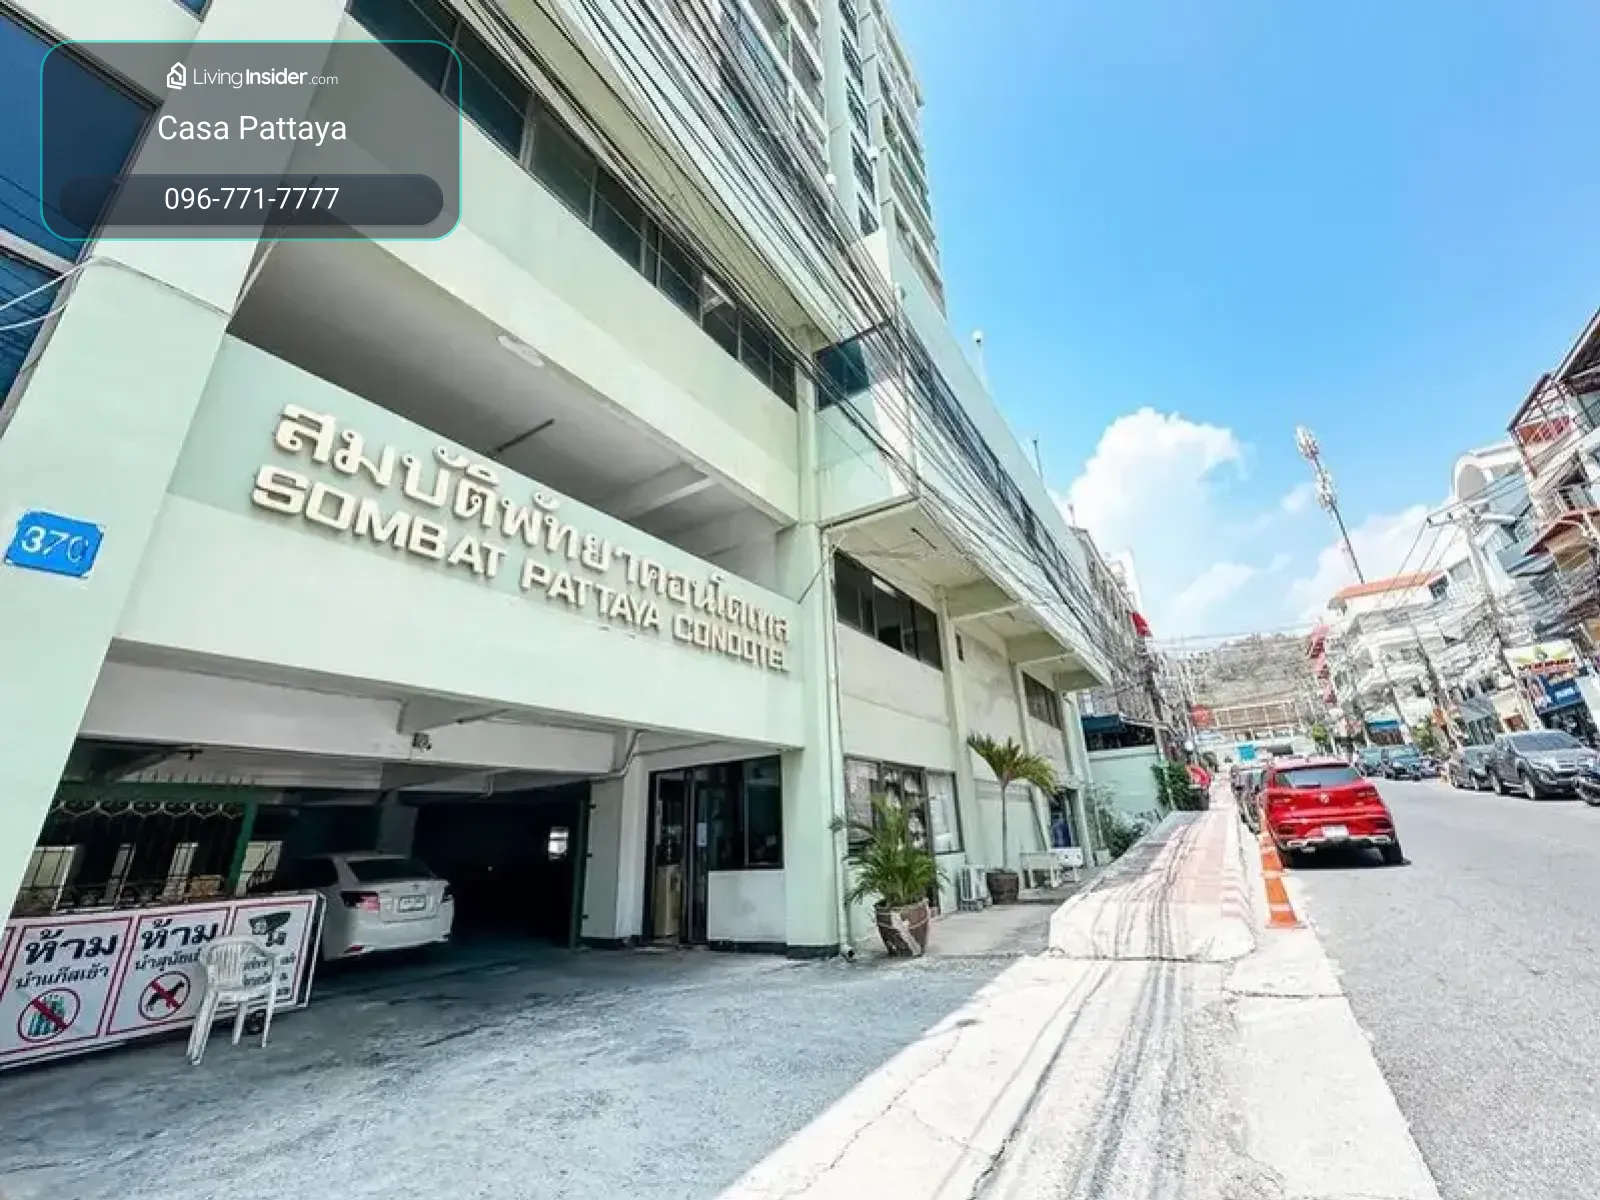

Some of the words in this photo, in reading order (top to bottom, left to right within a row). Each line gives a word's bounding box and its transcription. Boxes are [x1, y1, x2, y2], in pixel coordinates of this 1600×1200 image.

[21, 525, 89, 563] 370
[251, 464, 507, 579] SOMBAT
[521, 557, 661, 631] PATTAYA
[672, 612, 790, 672] CONDOTEL
[25, 928, 119, 966] ห้าม
[141, 918, 219, 951] ห้าม
